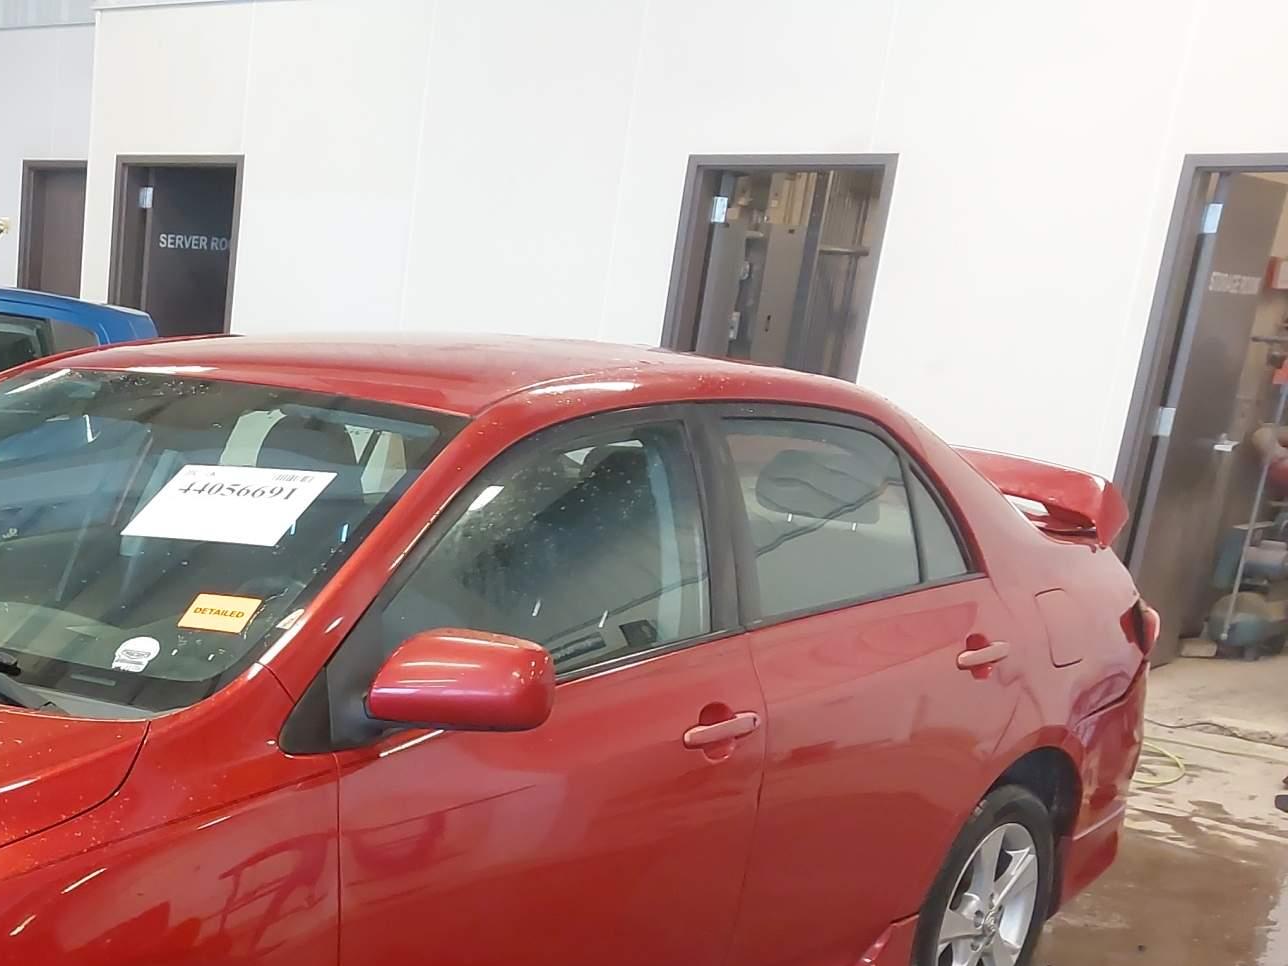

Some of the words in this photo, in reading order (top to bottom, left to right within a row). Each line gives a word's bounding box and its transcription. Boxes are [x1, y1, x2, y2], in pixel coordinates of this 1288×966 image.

[159, 233, 208, 250] SERVER
[210, 236, 231, 251] RO
[178, 481, 299, 501] 44056691
[193, 606, 245, 619] DETAILED
